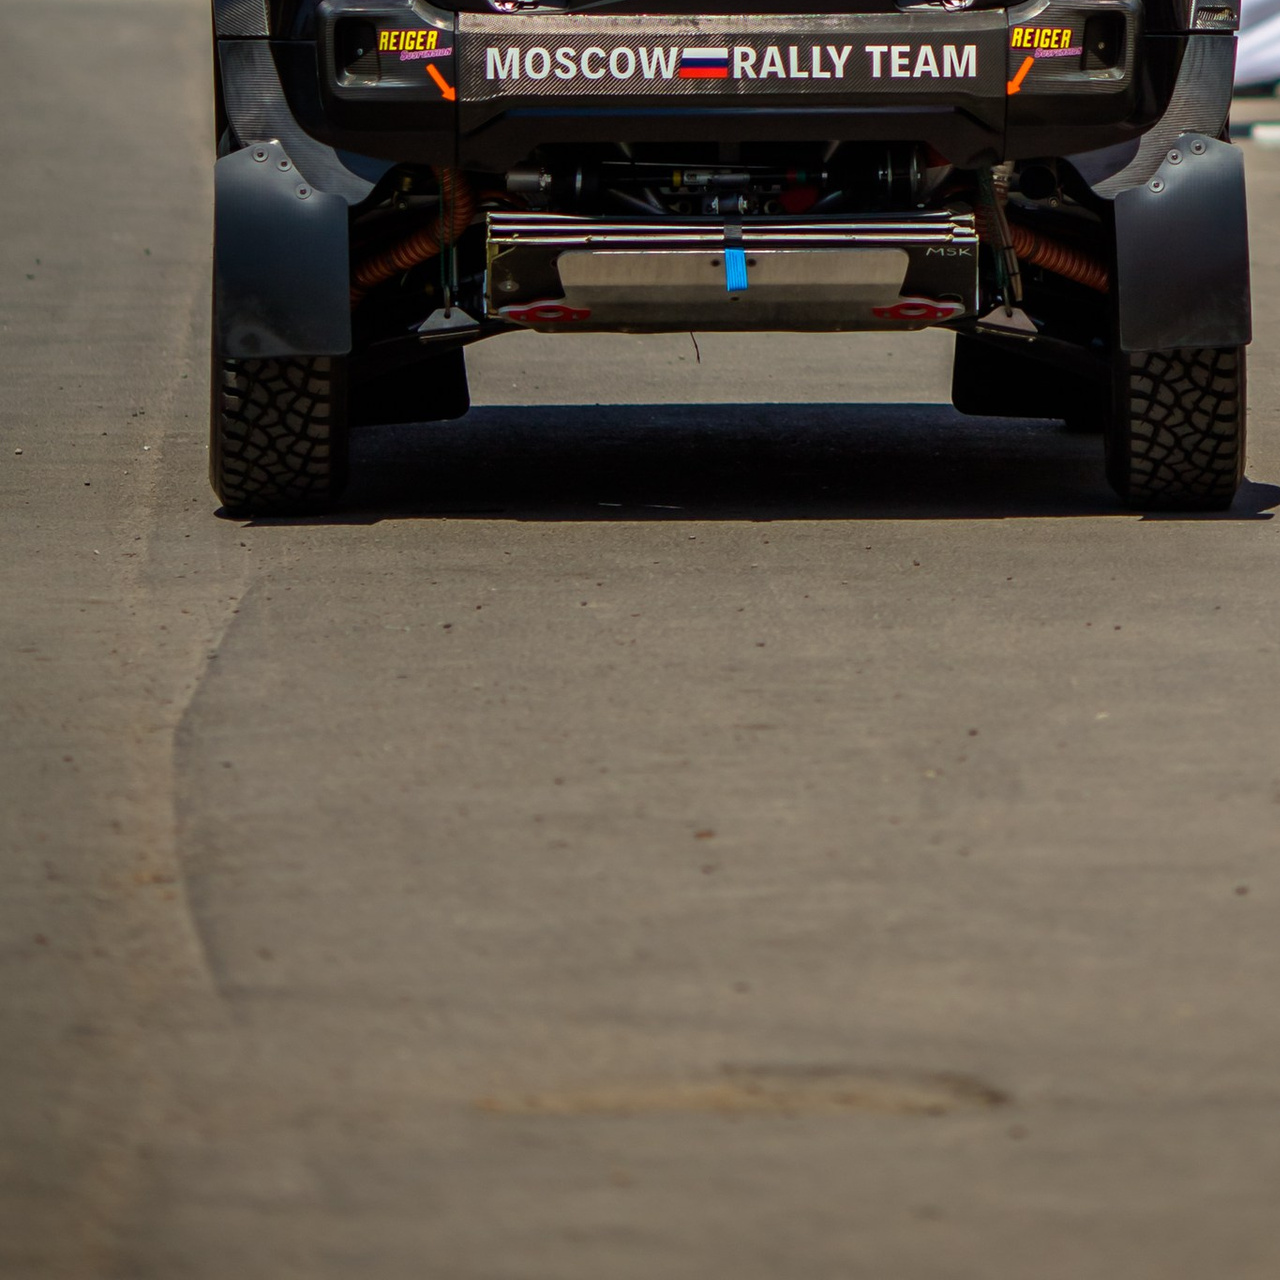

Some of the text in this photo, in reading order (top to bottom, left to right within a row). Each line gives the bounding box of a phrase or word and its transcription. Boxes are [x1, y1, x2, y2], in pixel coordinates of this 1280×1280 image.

[379, 30, 438, 51] REIGER
[1011, 27, 1072, 49] REIGER
[486, 45, 977, 80] MOSCOW RALLY TEAM
[926, 247, 972, 257] MSK
